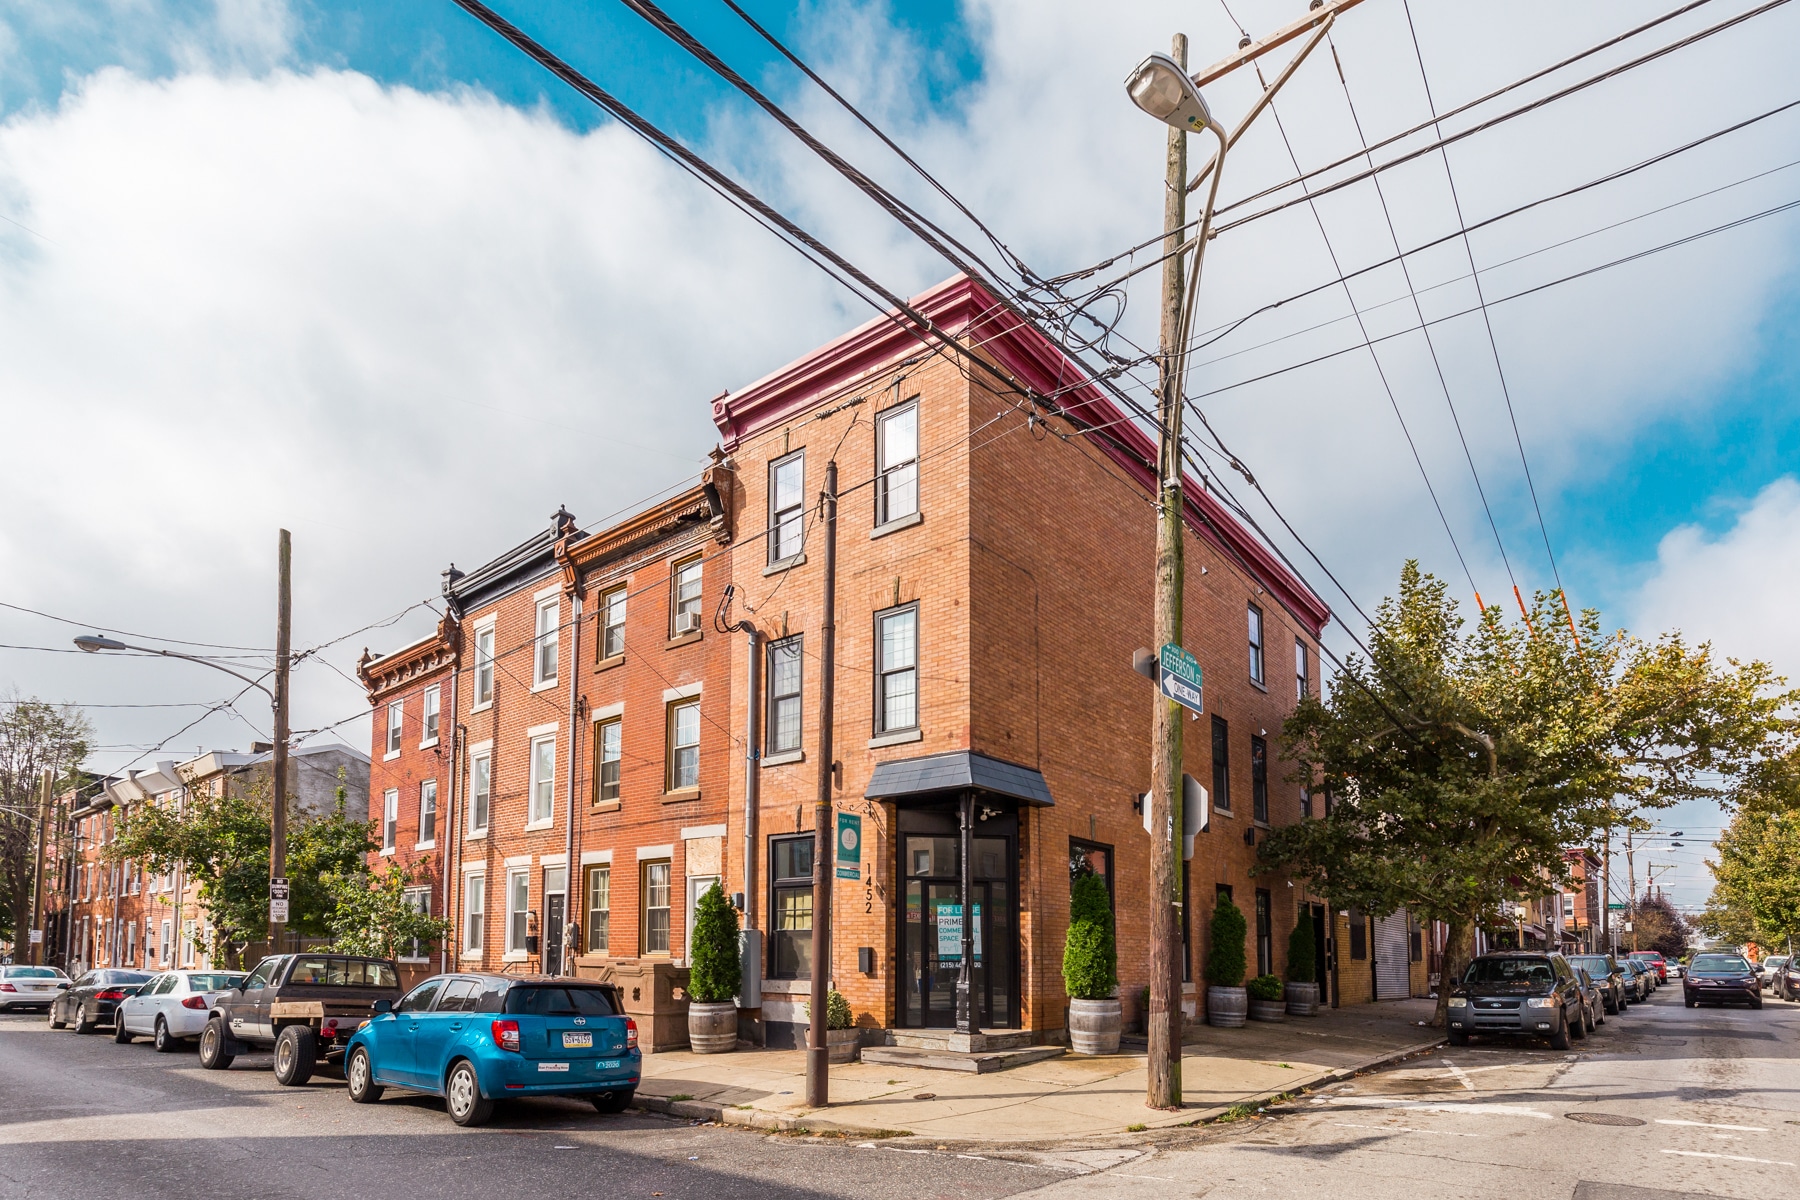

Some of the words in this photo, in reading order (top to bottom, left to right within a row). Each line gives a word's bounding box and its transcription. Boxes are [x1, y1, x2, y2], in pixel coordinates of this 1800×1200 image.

[1194, 120, 1203, 128] 10
[1162, 650, 1195, 681] JEFFERSON
[1195, 673, 1201, 685] ST
[1174, 682, 1186, 697] ONE
[1187, 688, 1199, 703] WAY
[836, 869, 860, 879] COMMERCIAL
[865, 863, 873, 914] 1452
[937, 906, 953, 914] FOR
[938, 918, 963, 926] PRIME
